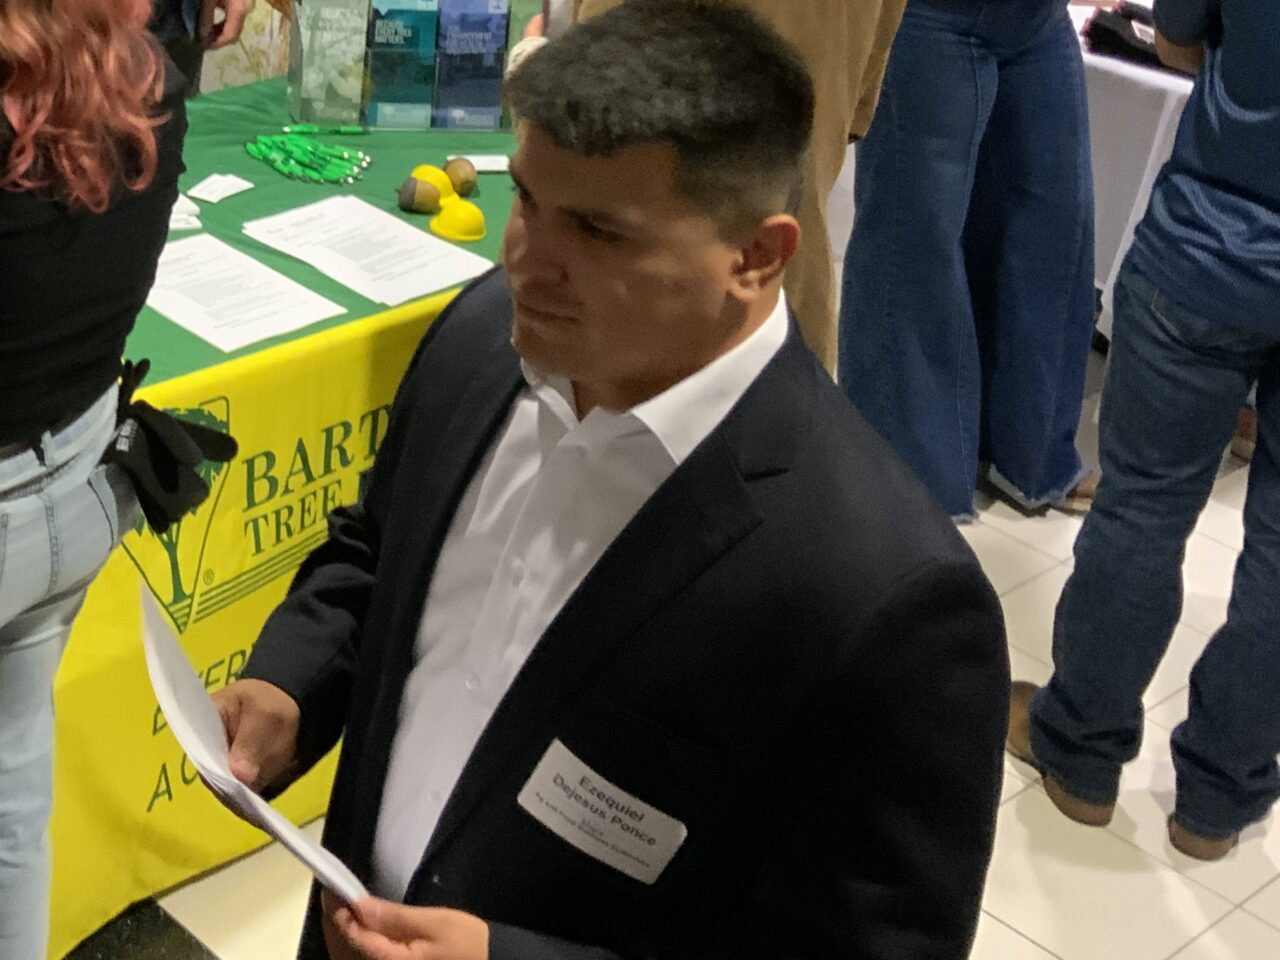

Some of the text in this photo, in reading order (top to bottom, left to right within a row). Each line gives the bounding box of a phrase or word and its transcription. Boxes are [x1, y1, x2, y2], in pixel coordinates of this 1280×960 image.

[242, 404, 392, 512] BART
[553, 773, 607, 819] Dejesus
[610, 815, 657, 847] Ponce
[579, 776, 646, 822] Ezequiel
